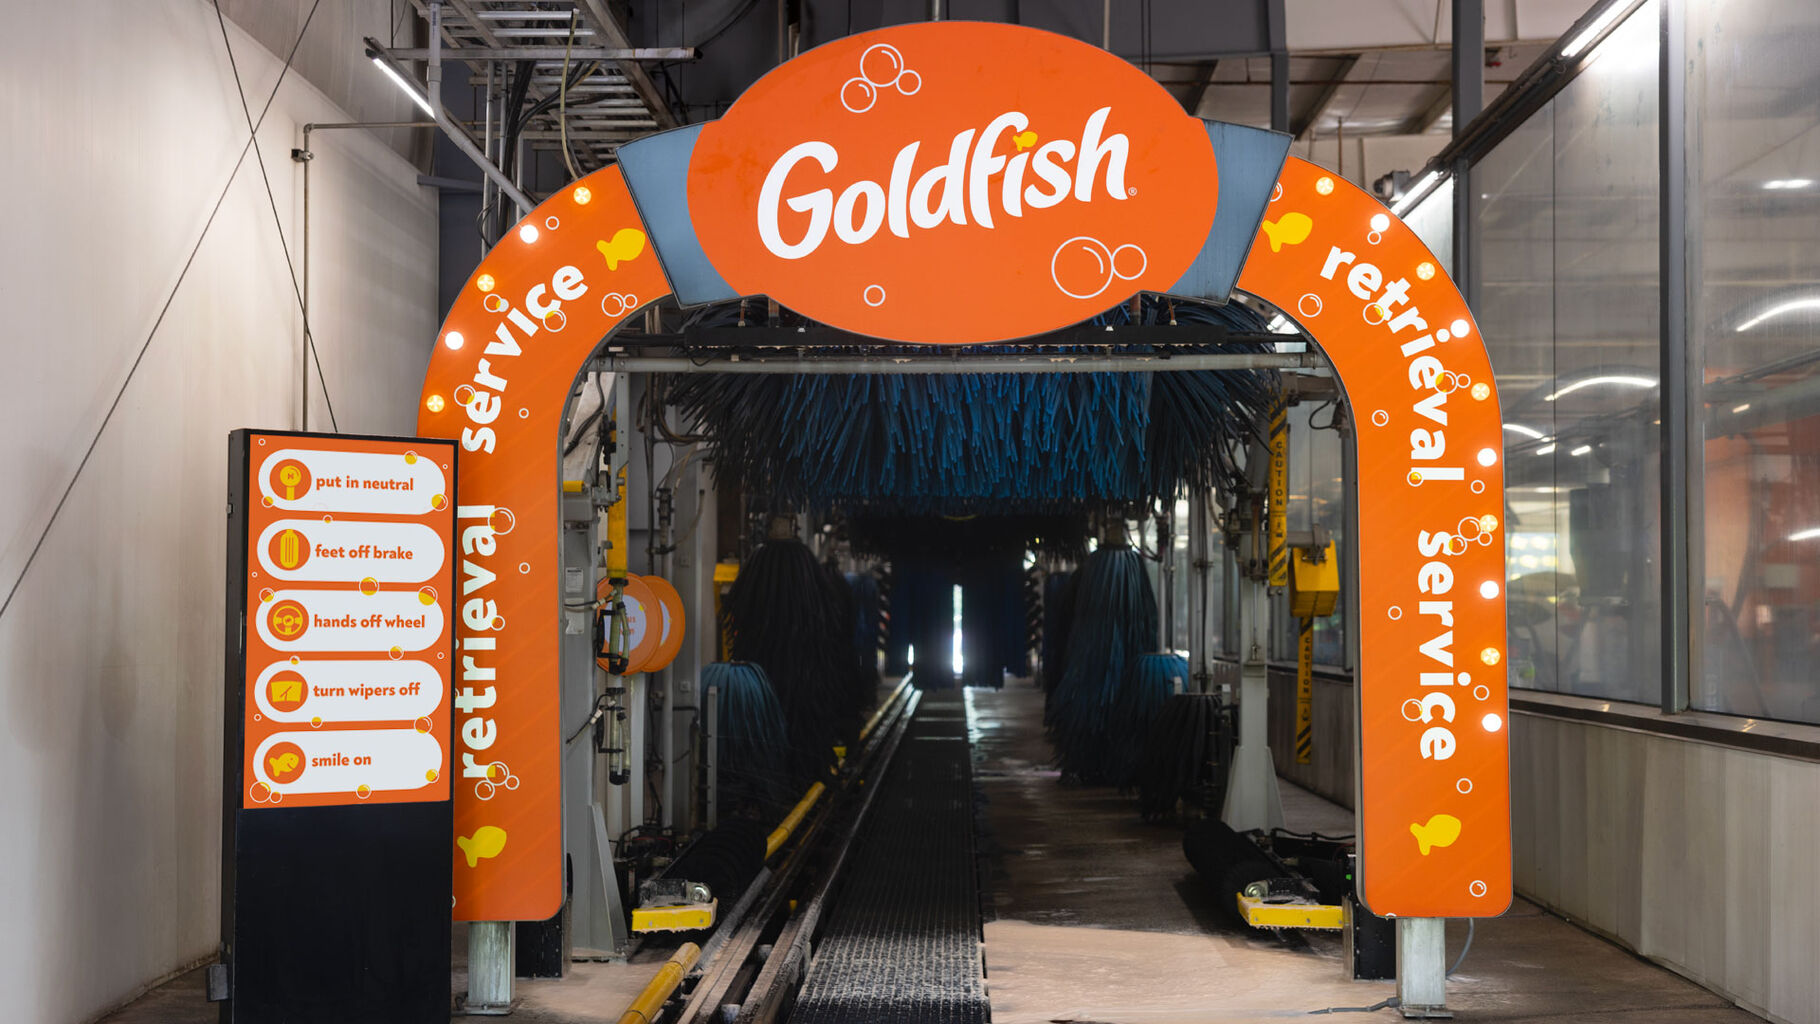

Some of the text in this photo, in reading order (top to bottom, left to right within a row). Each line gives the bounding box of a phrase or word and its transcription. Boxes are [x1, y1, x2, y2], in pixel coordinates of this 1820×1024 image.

[757, 106, 1129, 259] Goldfish
[316, 475, 414, 491] put in neutral
[1275, 441, 1283, 506] CAUTION
[1320, 245, 1472, 761] retrieval service
[455, 265, 589, 779] retrieval service
[315, 544, 414, 560] feet off brake
[313, 613, 426, 629] hands off wheel
[1303, 637, 1311, 693] CAUTION
[313, 682, 421, 700] turn wipers off
[311, 753, 372, 767] smile on
